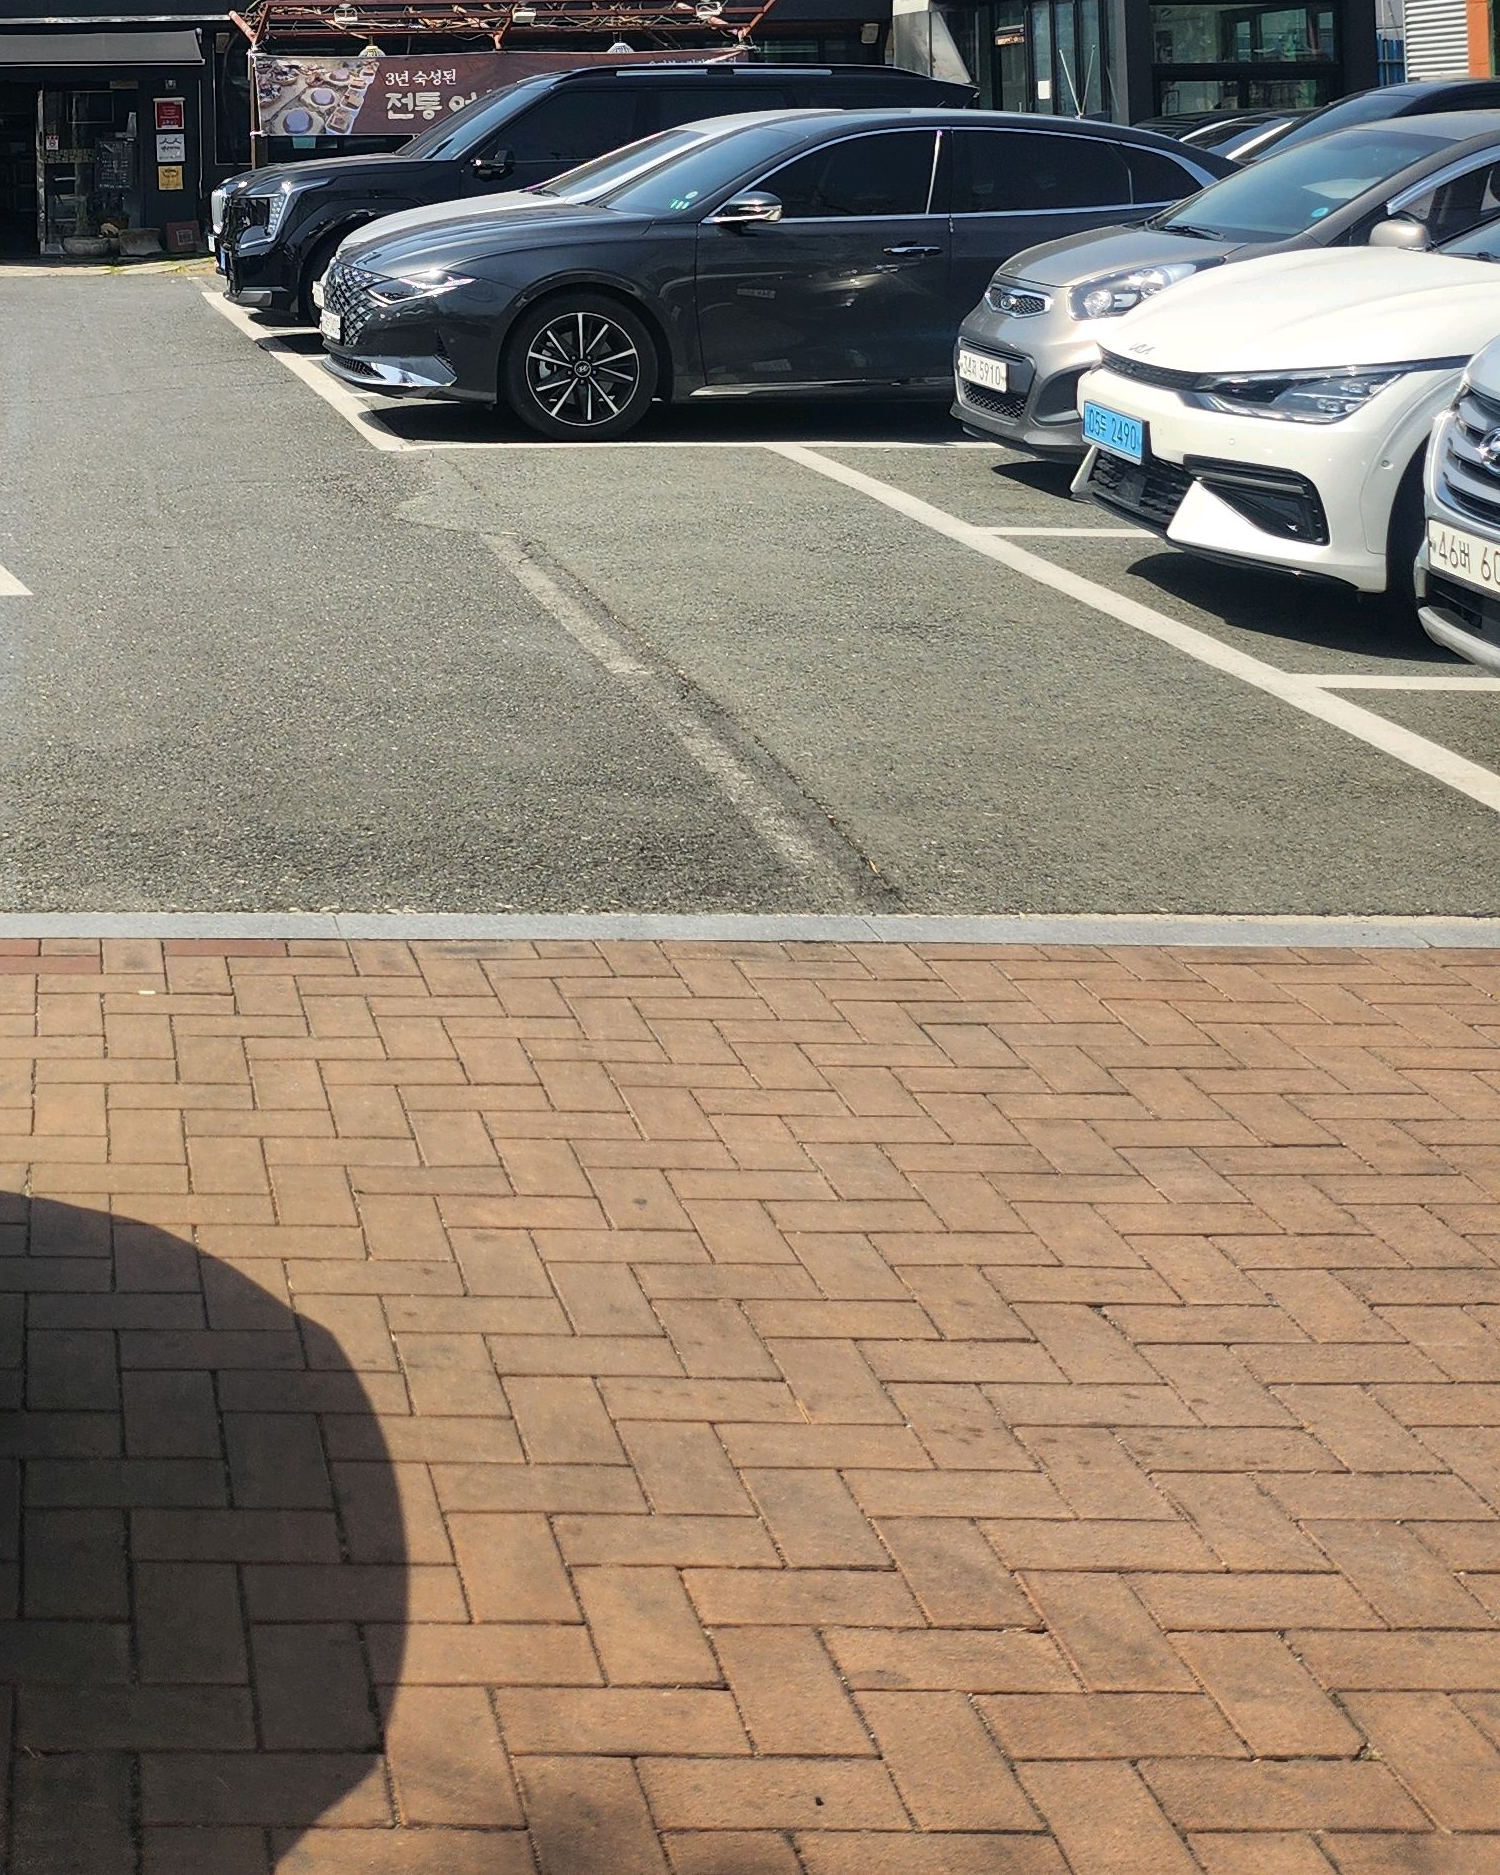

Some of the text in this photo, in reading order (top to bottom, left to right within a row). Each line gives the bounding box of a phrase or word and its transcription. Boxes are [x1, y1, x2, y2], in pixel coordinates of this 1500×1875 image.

[385, 68, 457, 87] 3년 숙성된
[385, 91, 443, 121] 전통
[1111, 417, 1137, 450] 2490
